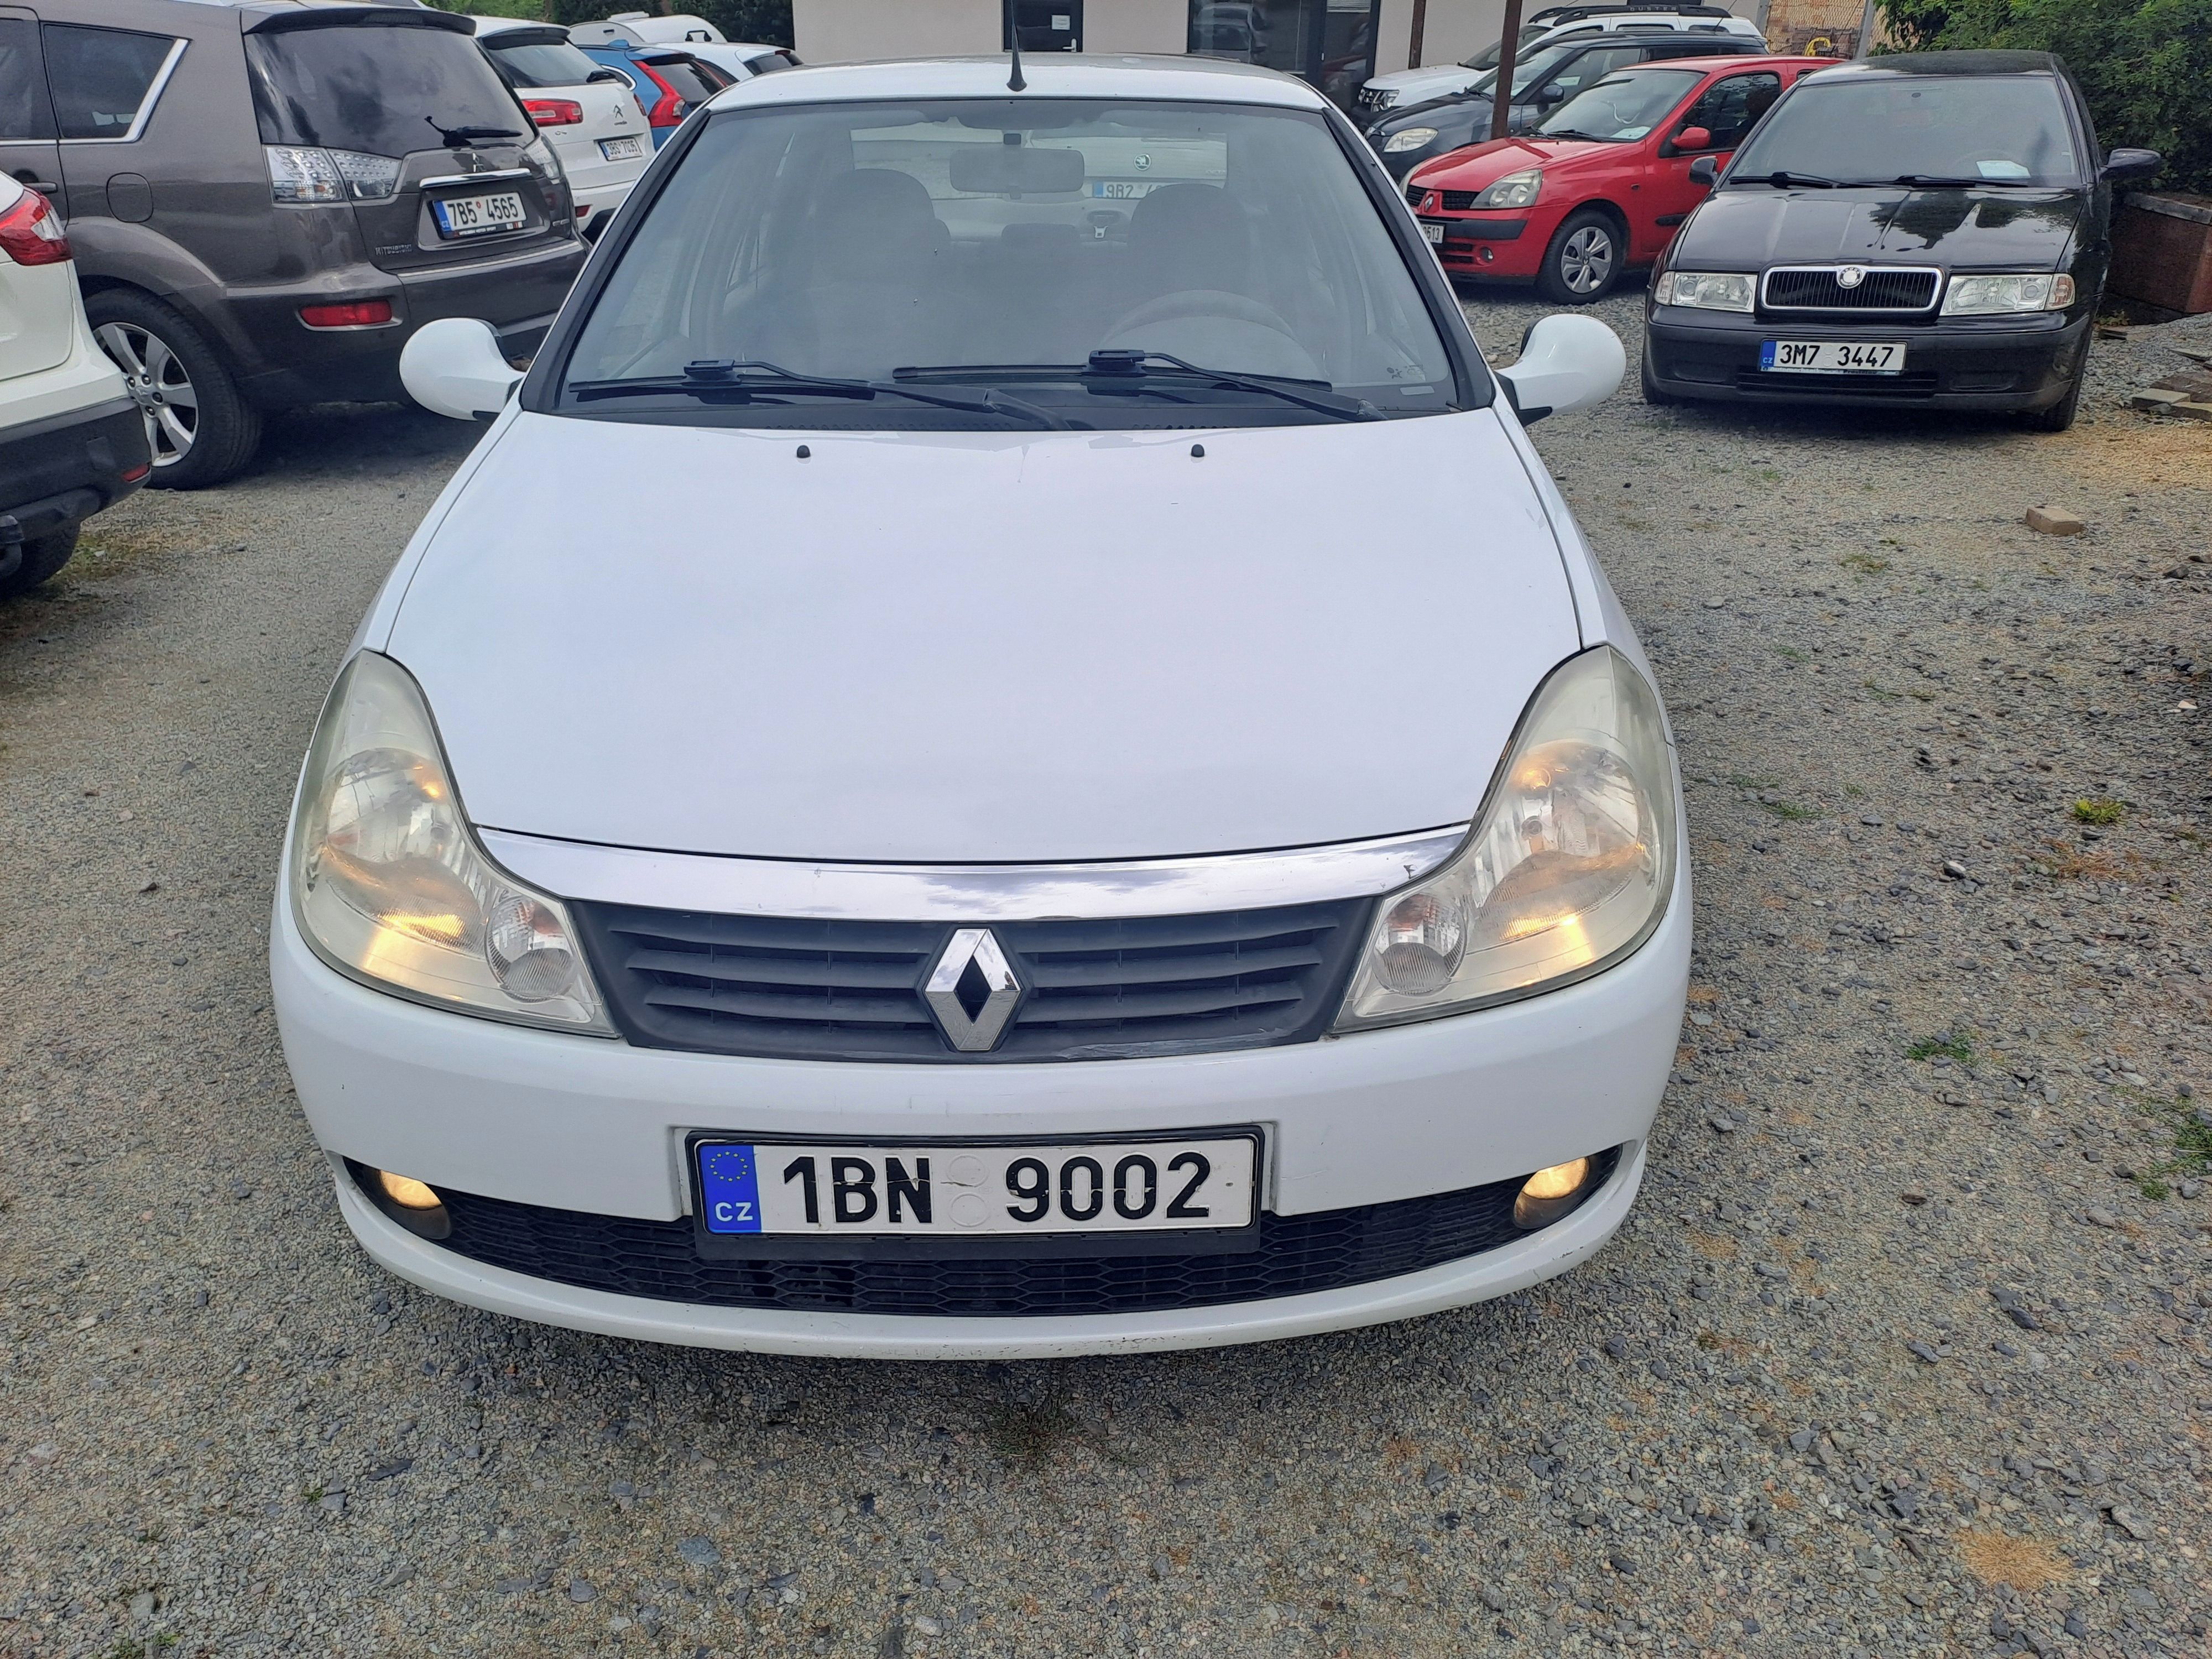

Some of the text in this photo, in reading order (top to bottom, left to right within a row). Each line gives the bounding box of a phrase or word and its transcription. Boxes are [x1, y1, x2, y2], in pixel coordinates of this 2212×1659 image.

[447, 201, 478, 226] 7B5
[486, 196, 519, 221] 4565
[1780, 344, 1820, 365] 3M7
[1837, 346, 1894, 367] 3447
[715, 1151, 1211, 1223] CZ 1BN 9002
